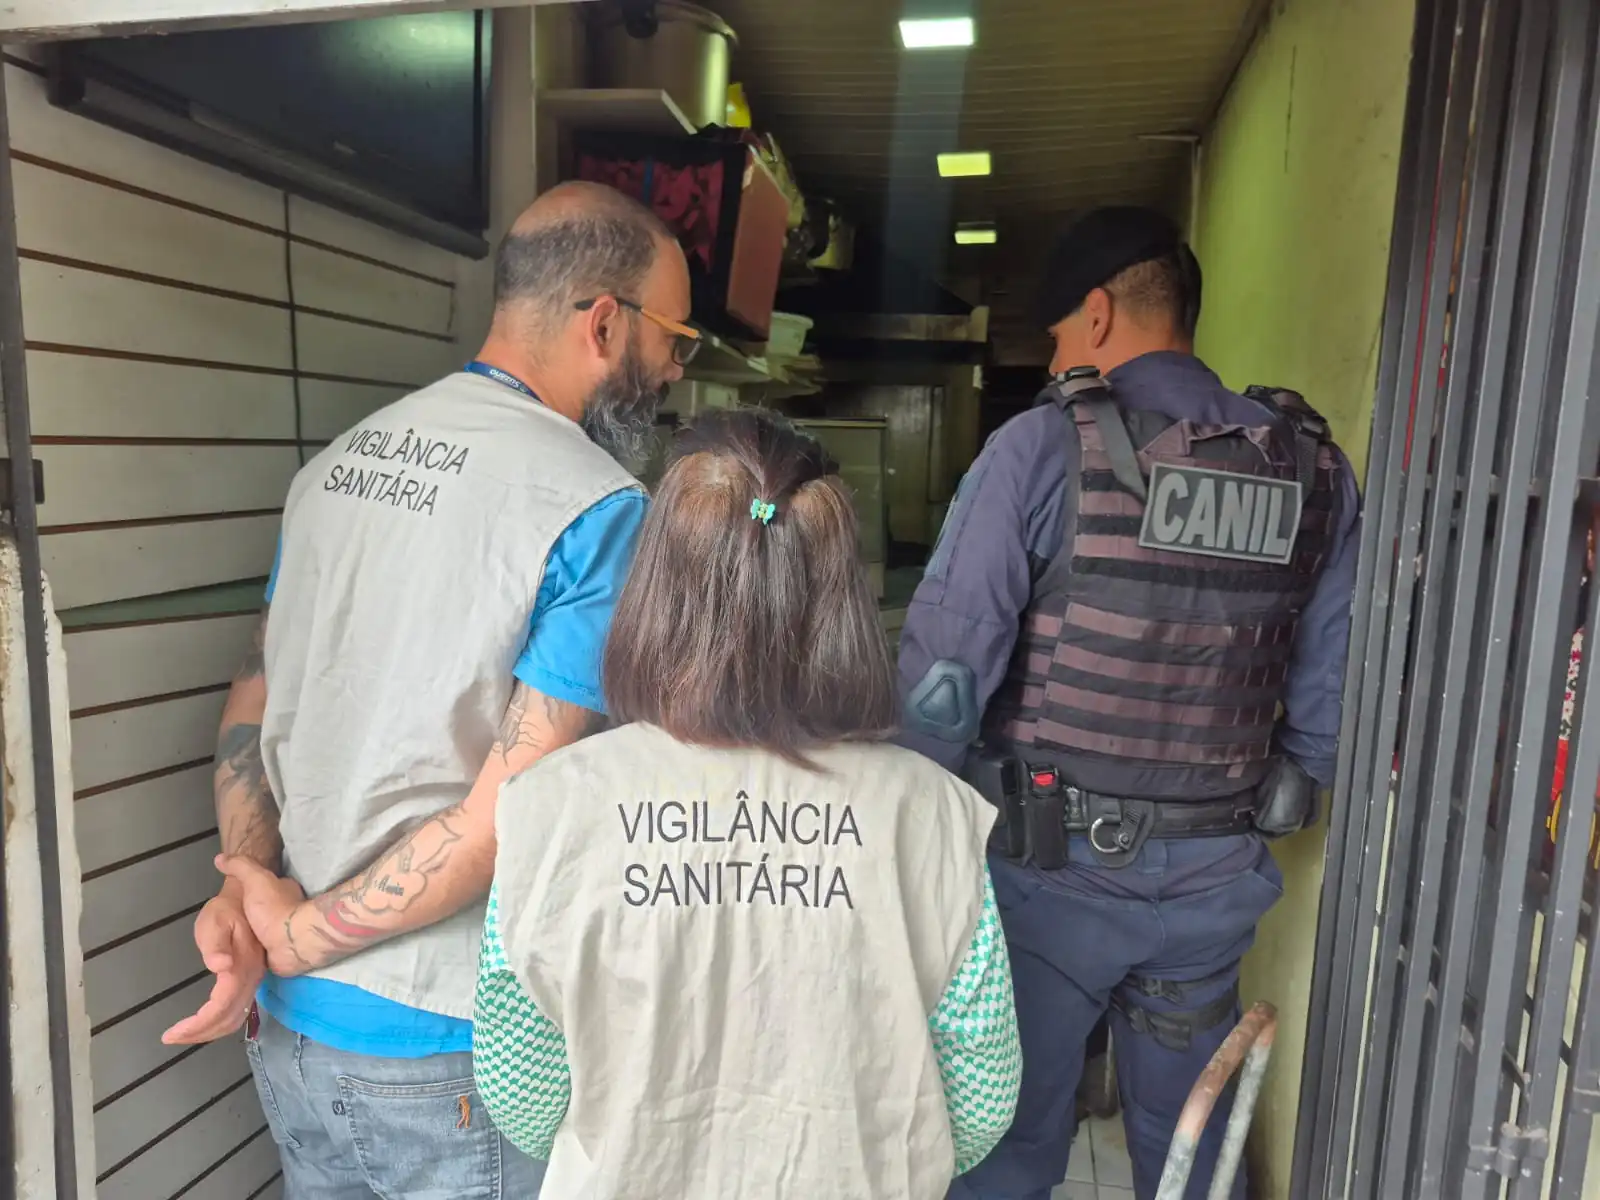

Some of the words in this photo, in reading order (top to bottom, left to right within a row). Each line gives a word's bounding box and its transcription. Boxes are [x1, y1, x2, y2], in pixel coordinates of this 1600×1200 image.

[345, 428, 469, 475] VIGILÂNCIA
[324, 464, 439, 516] SANITÁRIA
[1152, 472, 1289, 556] CANIL
[617, 790, 863, 847] VIGILÂNCIA
[623, 853, 854, 909] SANITÁRIA
